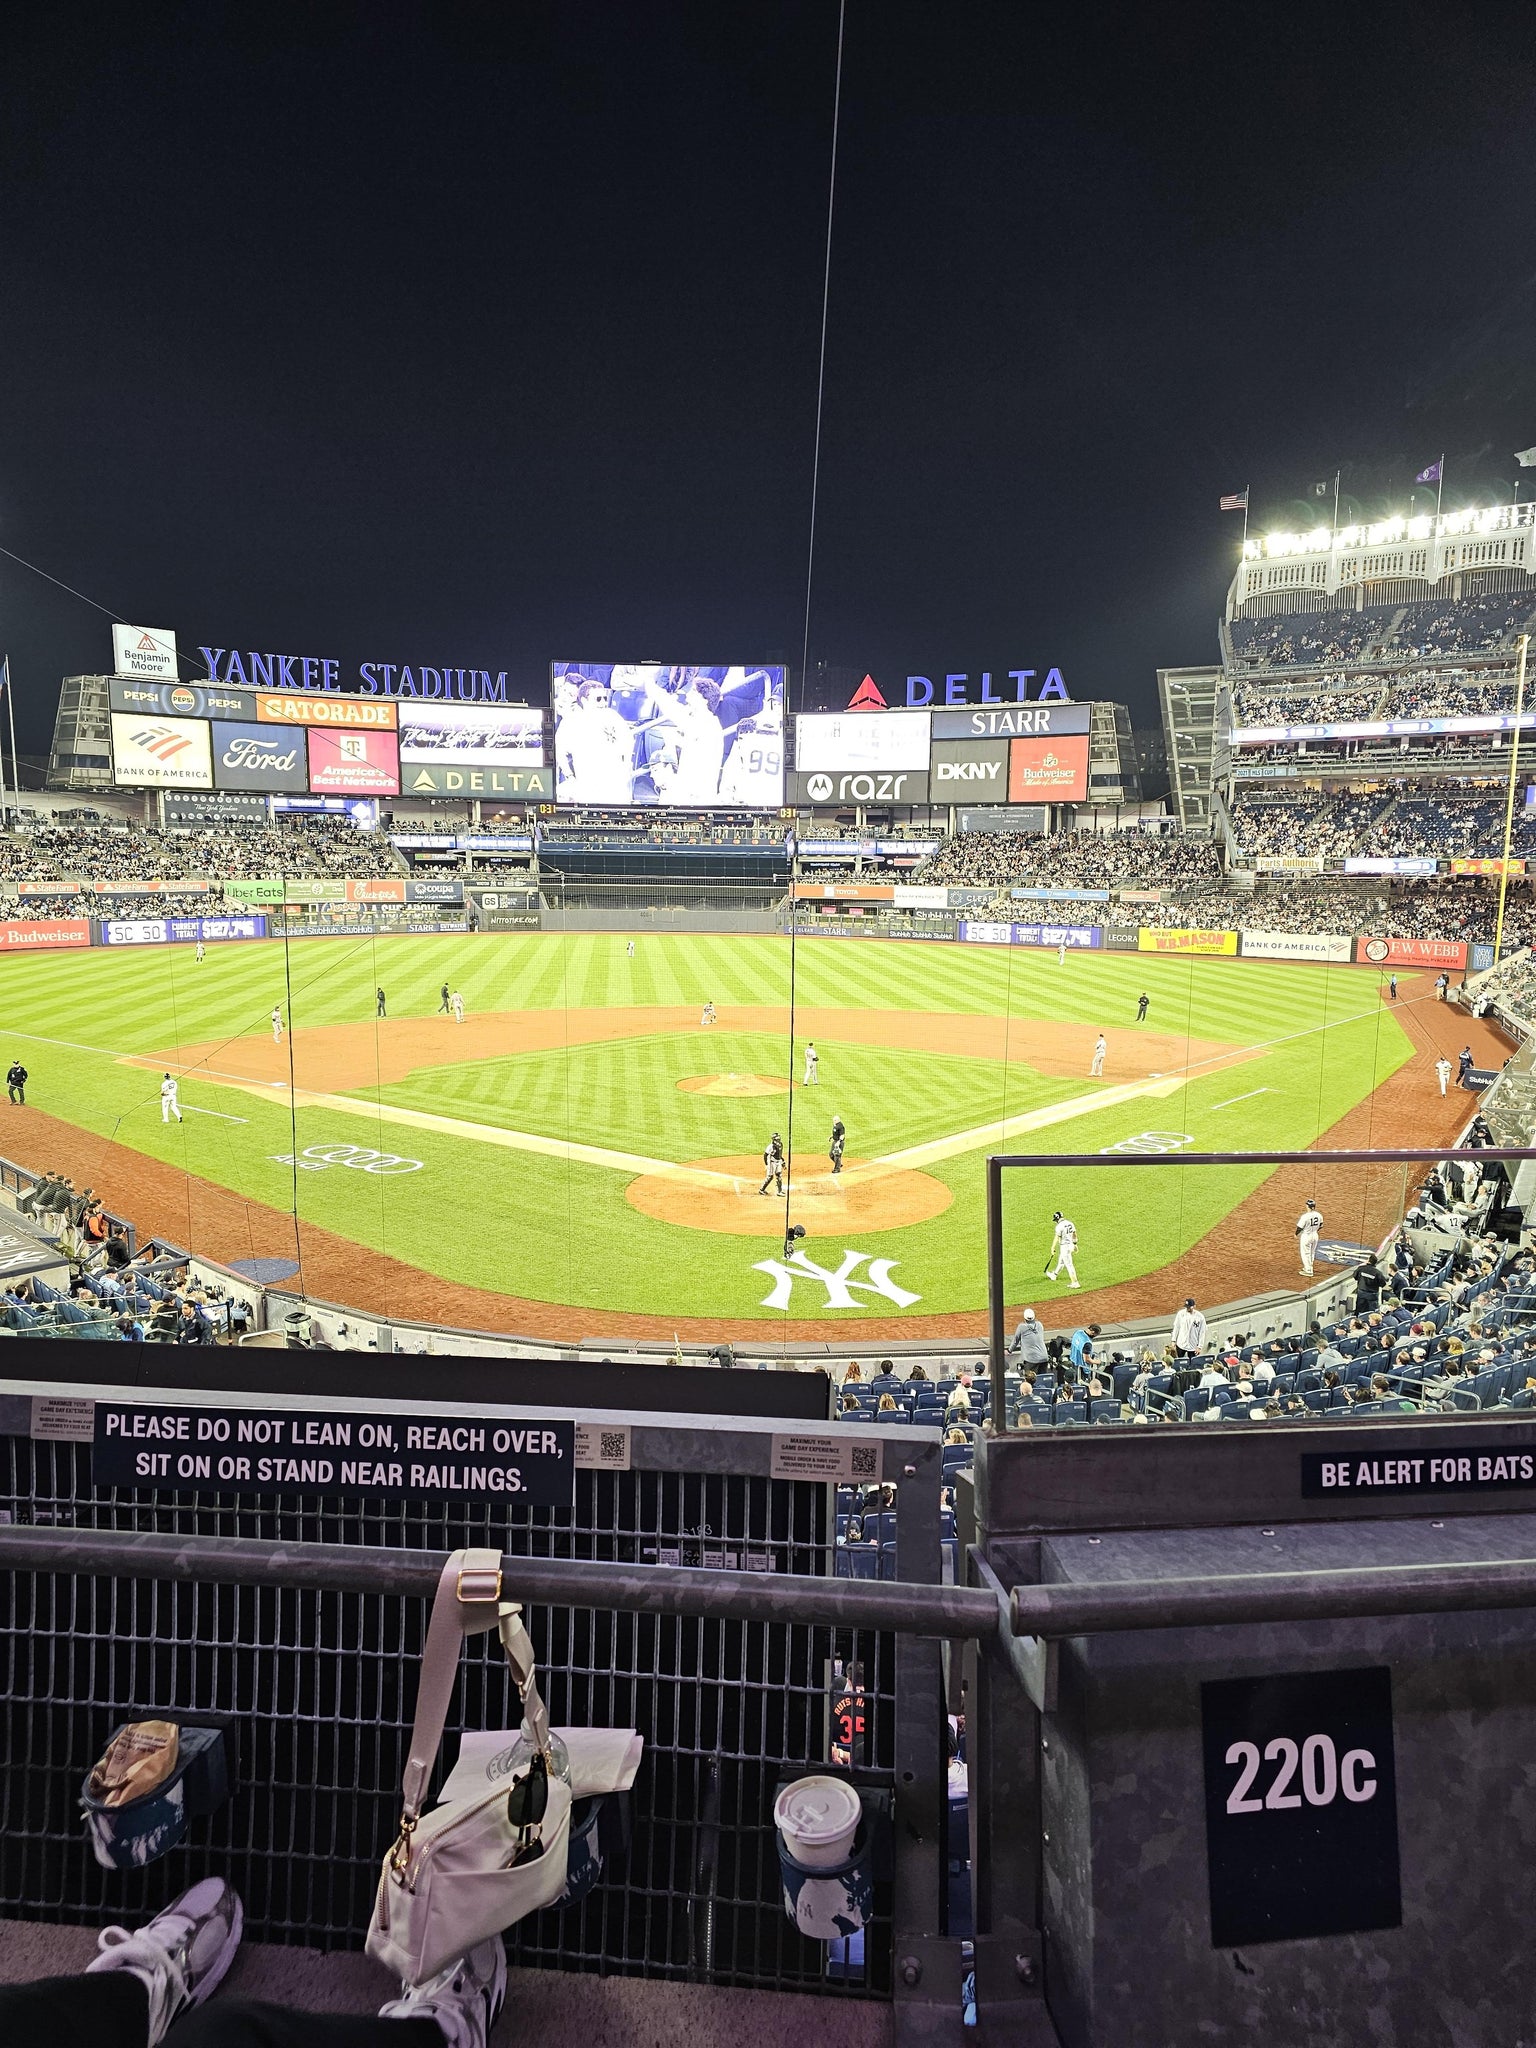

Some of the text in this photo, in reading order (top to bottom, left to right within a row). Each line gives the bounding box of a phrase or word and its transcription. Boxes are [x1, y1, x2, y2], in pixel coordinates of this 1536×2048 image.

[124, 650, 171, 664] Benjamin
[131, 661, 164, 672] Moore
[197, 646, 508, 702] YANKEE STADIUM
[906, 667, 1069, 706] DELTA
[123, 690, 159, 702] PEPSI
[172, 696, 195, 704] PEPSI
[208, 698, 242, 710] PEPSI
[265, 699, 390, 724] GATORADE
[971, 709, 1050, 734] STARR
[222, 738, 296, 771] Ford
[749, 750, 780, 775] 99
[116, 767, 208, 778] BANK OF AMERICA
[322, 766, 385, 778] America's
[937, 762, 1002, 779] DKNY
[1023, 768, 1076, 779] Budweiser
[312, 776, 397, 788] Best Network
[446, 771, 545, 793] DELTA
[839, 774, 908, 800] razr
[1260, 858, 1320, 868] Parts Authority
[37, 884, 75, 892] State Farm
[114, 883, 133, 891] State
[227, 887, 254, 898] Uber
[256, 887, 284, 898] Eats
[426, 885, 454, 894] coupa
[484, 897, 496, 906] GS
[915, 910, 952, 919] StubHub
[274, 928, 305, 937] StubHub
[306, 927, 339, 936] StubHub
[340, 926, 373, 935] StubHub
[408, 924, 434, 932] STARR
[823, 927, 847, 936] STARR
[1108, 933, 1138, 943] LEGORA
[1244, 941, 1327, 951] BANK OF AMERICA
[1391, 941, 1460, 957] F.W. WEBB
[1501, 949, 1512, 957] 314
[1476, 960, 1490, 968] LIFE
[1469, 1076, 1494, 1085] StubHub
[1310, 1217, 1319, 1227] 12
[1449, 1218, 1459, 1227] 17
[106, 1413, 190, 1440] PLEASE
[197, 1418, 230, 1442] DO
[237, 1420, 285, 1444] NOT
[291, 1421, 351, 1446] LEAN
[358, 1423, 399, 1453] ON,
[406, 1426, 485, 1452] REACH
[492, 1429, 564, 1459] OVER,
[135, 1452, 528, 1493] SIT ON OR STAND NEAR RAILINGS.
[1322, 1455, 1534, 1487] BE ALERT FOR BATS
